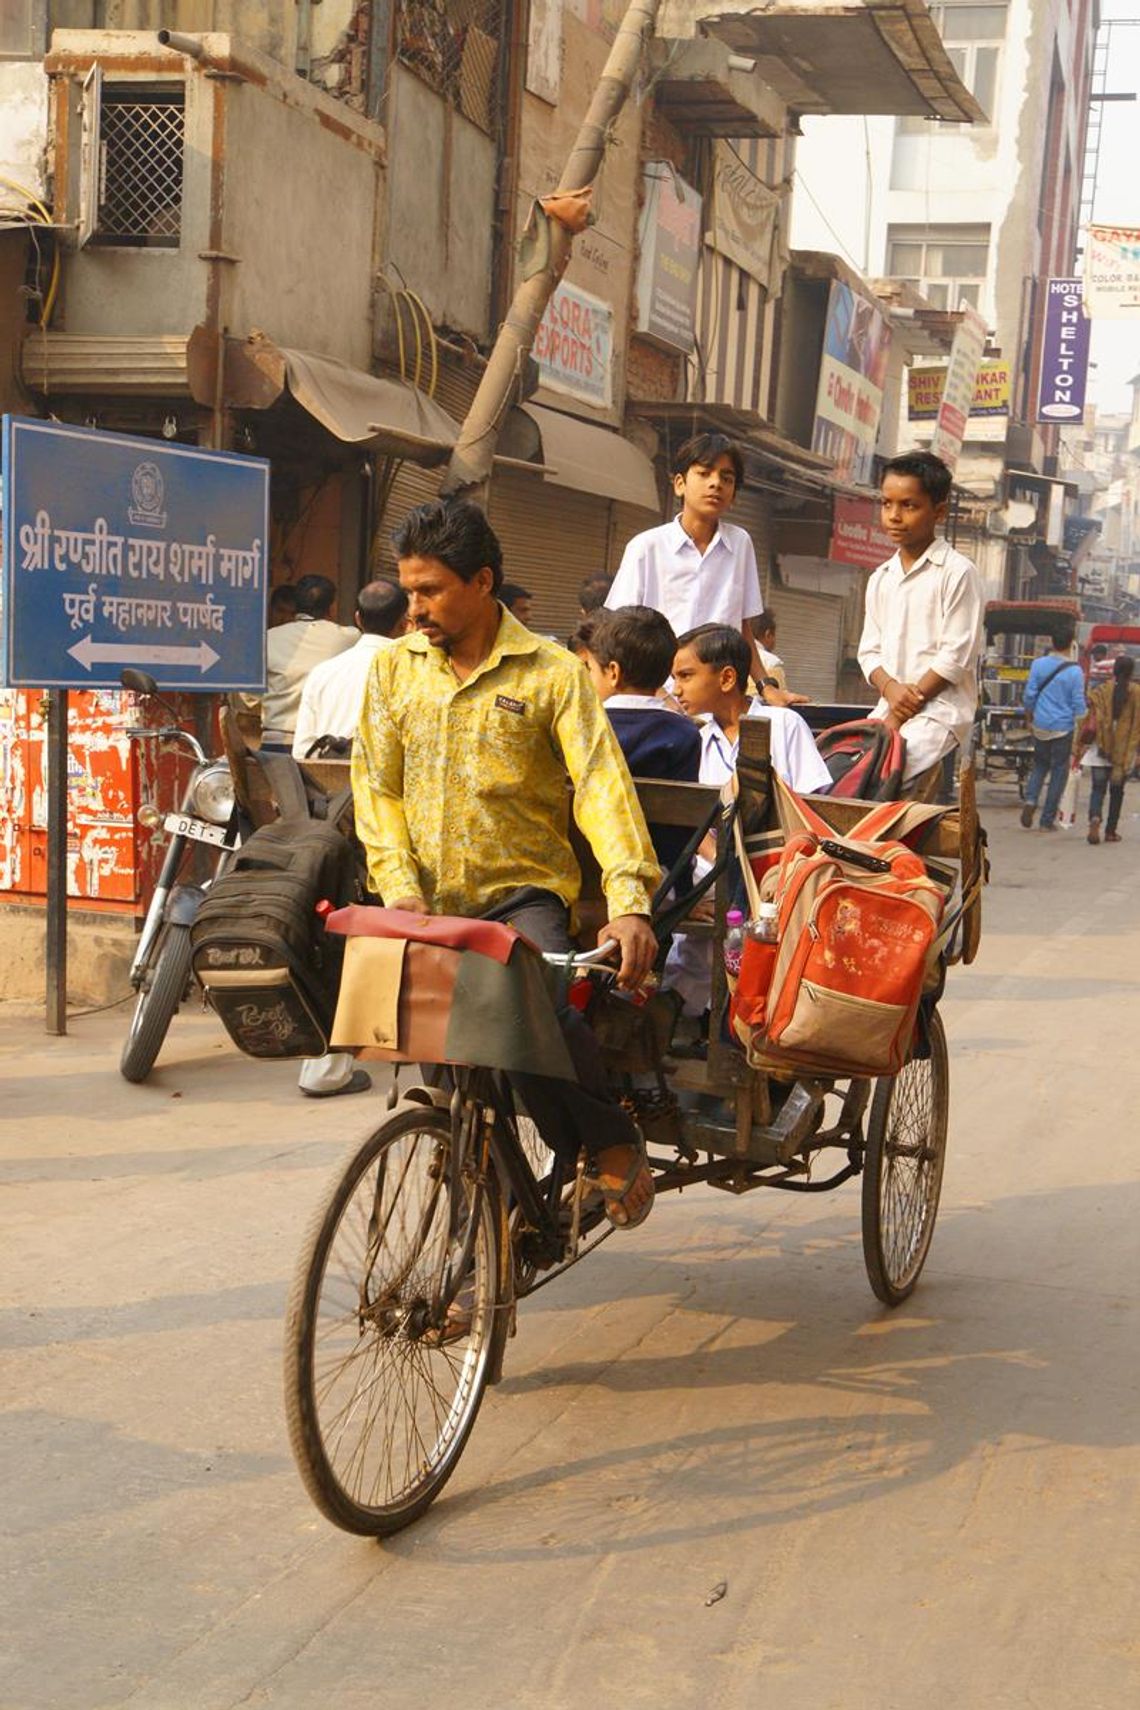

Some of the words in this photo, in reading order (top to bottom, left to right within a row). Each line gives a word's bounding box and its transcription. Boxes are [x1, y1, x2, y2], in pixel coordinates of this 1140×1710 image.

[535, 322, 593, 377] EXPORTS
[1053, 294, 1080, 402] SHELTON
[910, 375, 940, 389] SHIV
[20, 510, 51, 571] श्री
[127, 537, 166, 580] राय
[169, 535, 216, 585] शर्मा
[219, 538, 261, 588] मार्ग
[63, 583, 97, 630] पूर्व
[101, 596, 173, 631] महानगर
[176, 593, 226, 633] पार्षद
